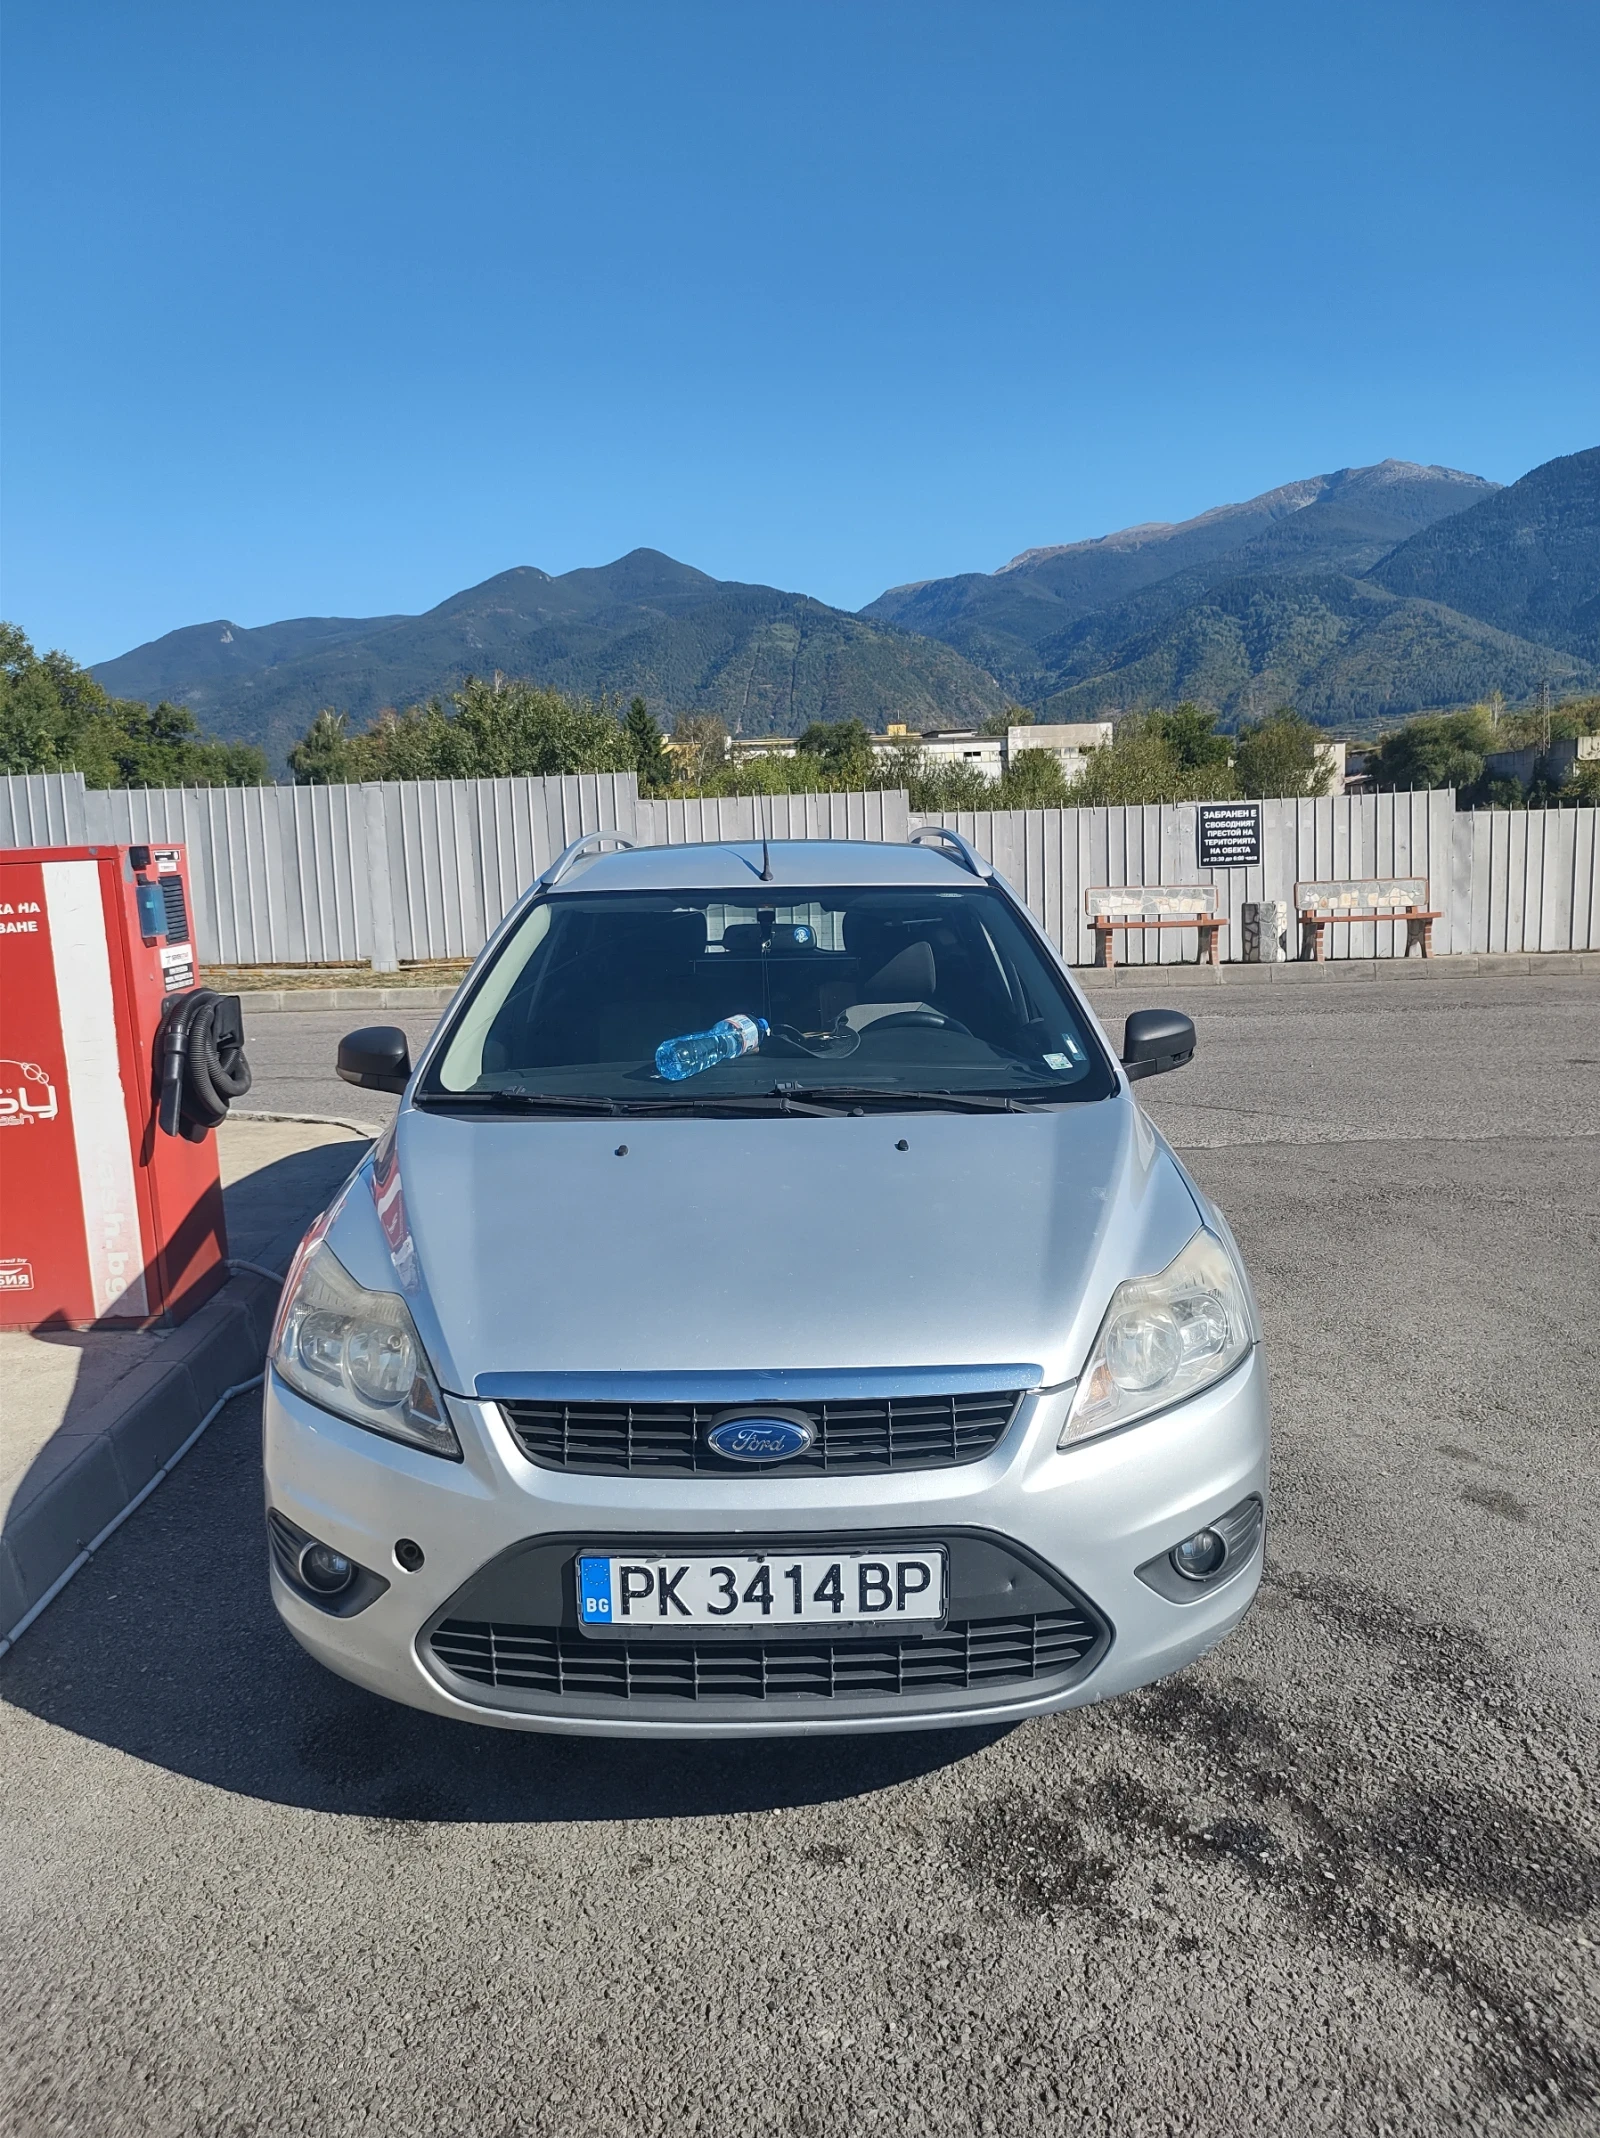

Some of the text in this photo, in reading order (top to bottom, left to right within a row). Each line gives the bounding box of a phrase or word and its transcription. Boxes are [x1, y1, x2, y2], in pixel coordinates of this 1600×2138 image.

[1203, 809, 1257, 819] ЗАБРАНЕН Е
[1205, 820, 1255, 829] СВОБОДНИЯТ
[1207, 828, 1253, 837] ПРЕСТОЙ НА
[1204, 837, 1256, 846] ТЕРИТОРИЯТА
[1222, 846, 1251, 854] ОБЕКТА
[18, 902, 41, 914] НА
[732, 1429, 785, 1451] Ford
[619, 1561, 931, 1616] PK 3414 BP
[586, 1597, 609, 1613] BG
